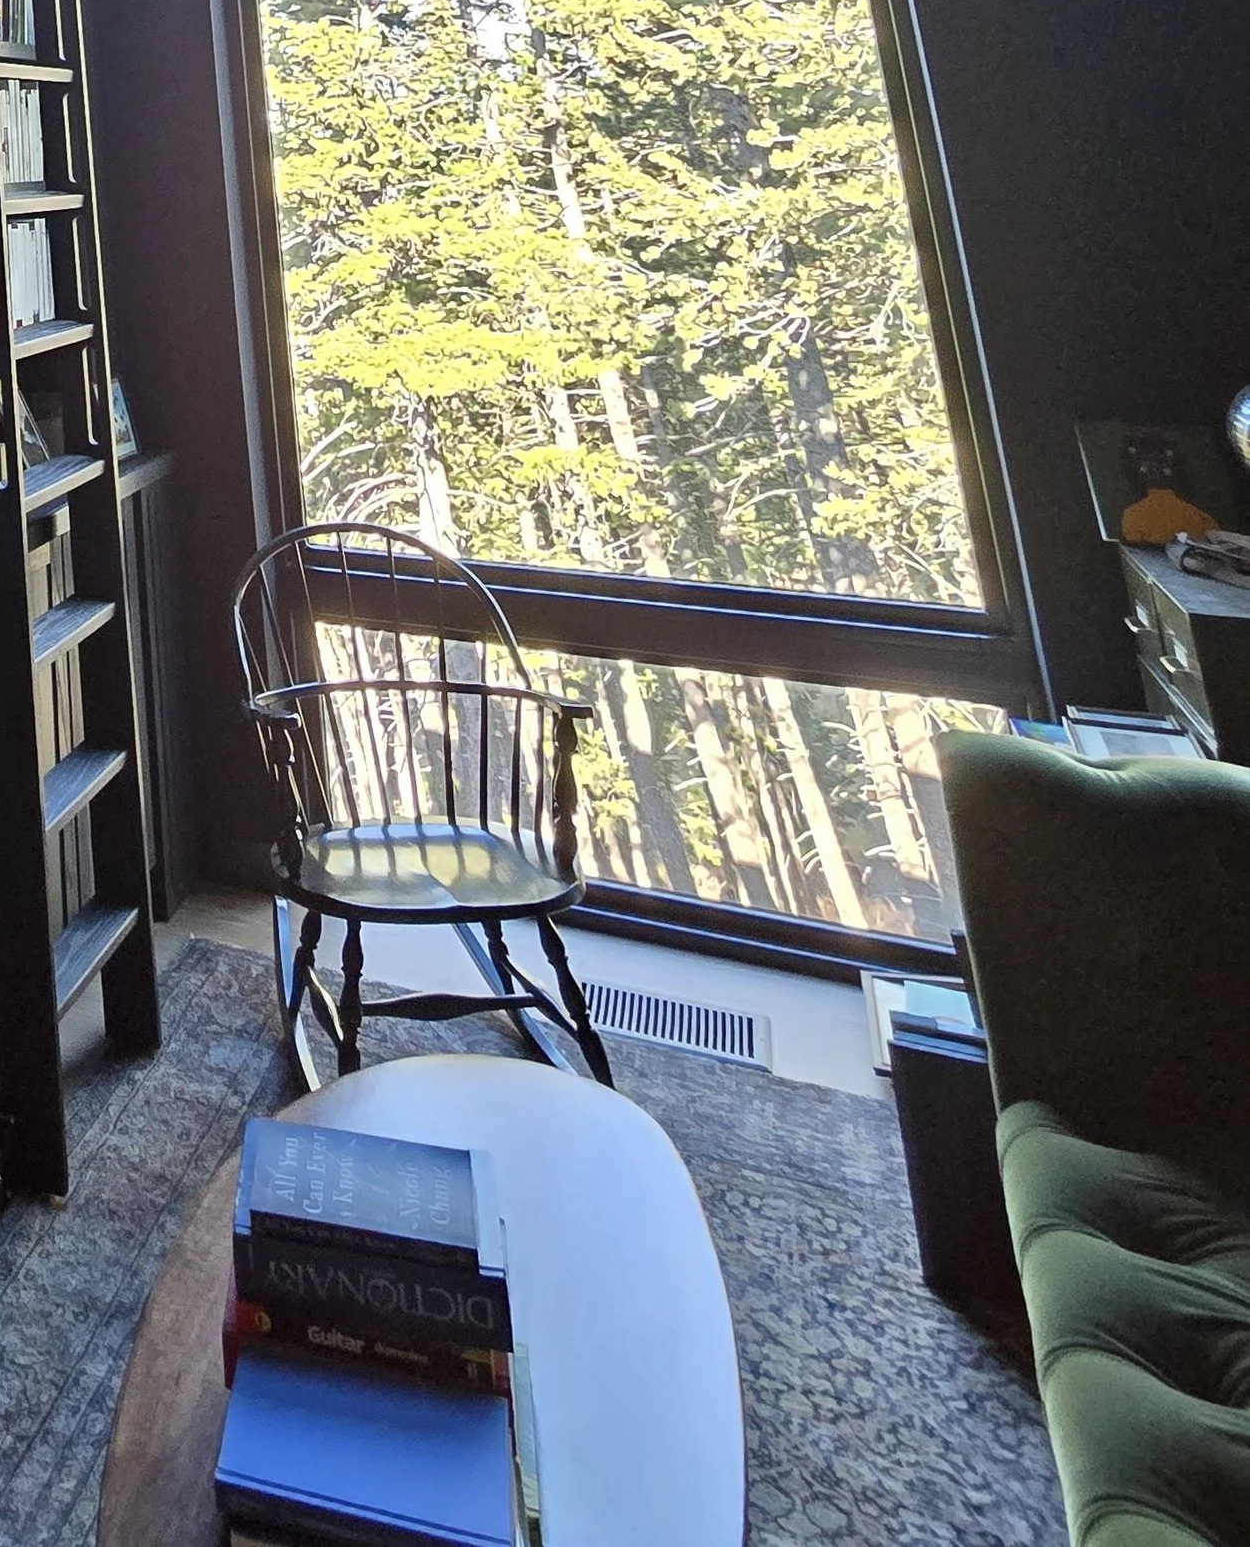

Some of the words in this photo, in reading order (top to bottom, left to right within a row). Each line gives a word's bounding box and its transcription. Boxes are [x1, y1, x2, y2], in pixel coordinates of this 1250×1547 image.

[277, 1136, 301, 1167] You
[306, 1132, 328, 1173] Ever
[272, 1173, 297, 1202] All
[302, 1179, 325, 1214] Can
[333, 1153, 355, 1204] Know
[397, 1160, 422, 1219] Nicole
[427, 1166, 453, 1226] Chung
[265, 1259, 496, 1330] DICTIONARY
[306, 1324, 367, 1355] Guitar
